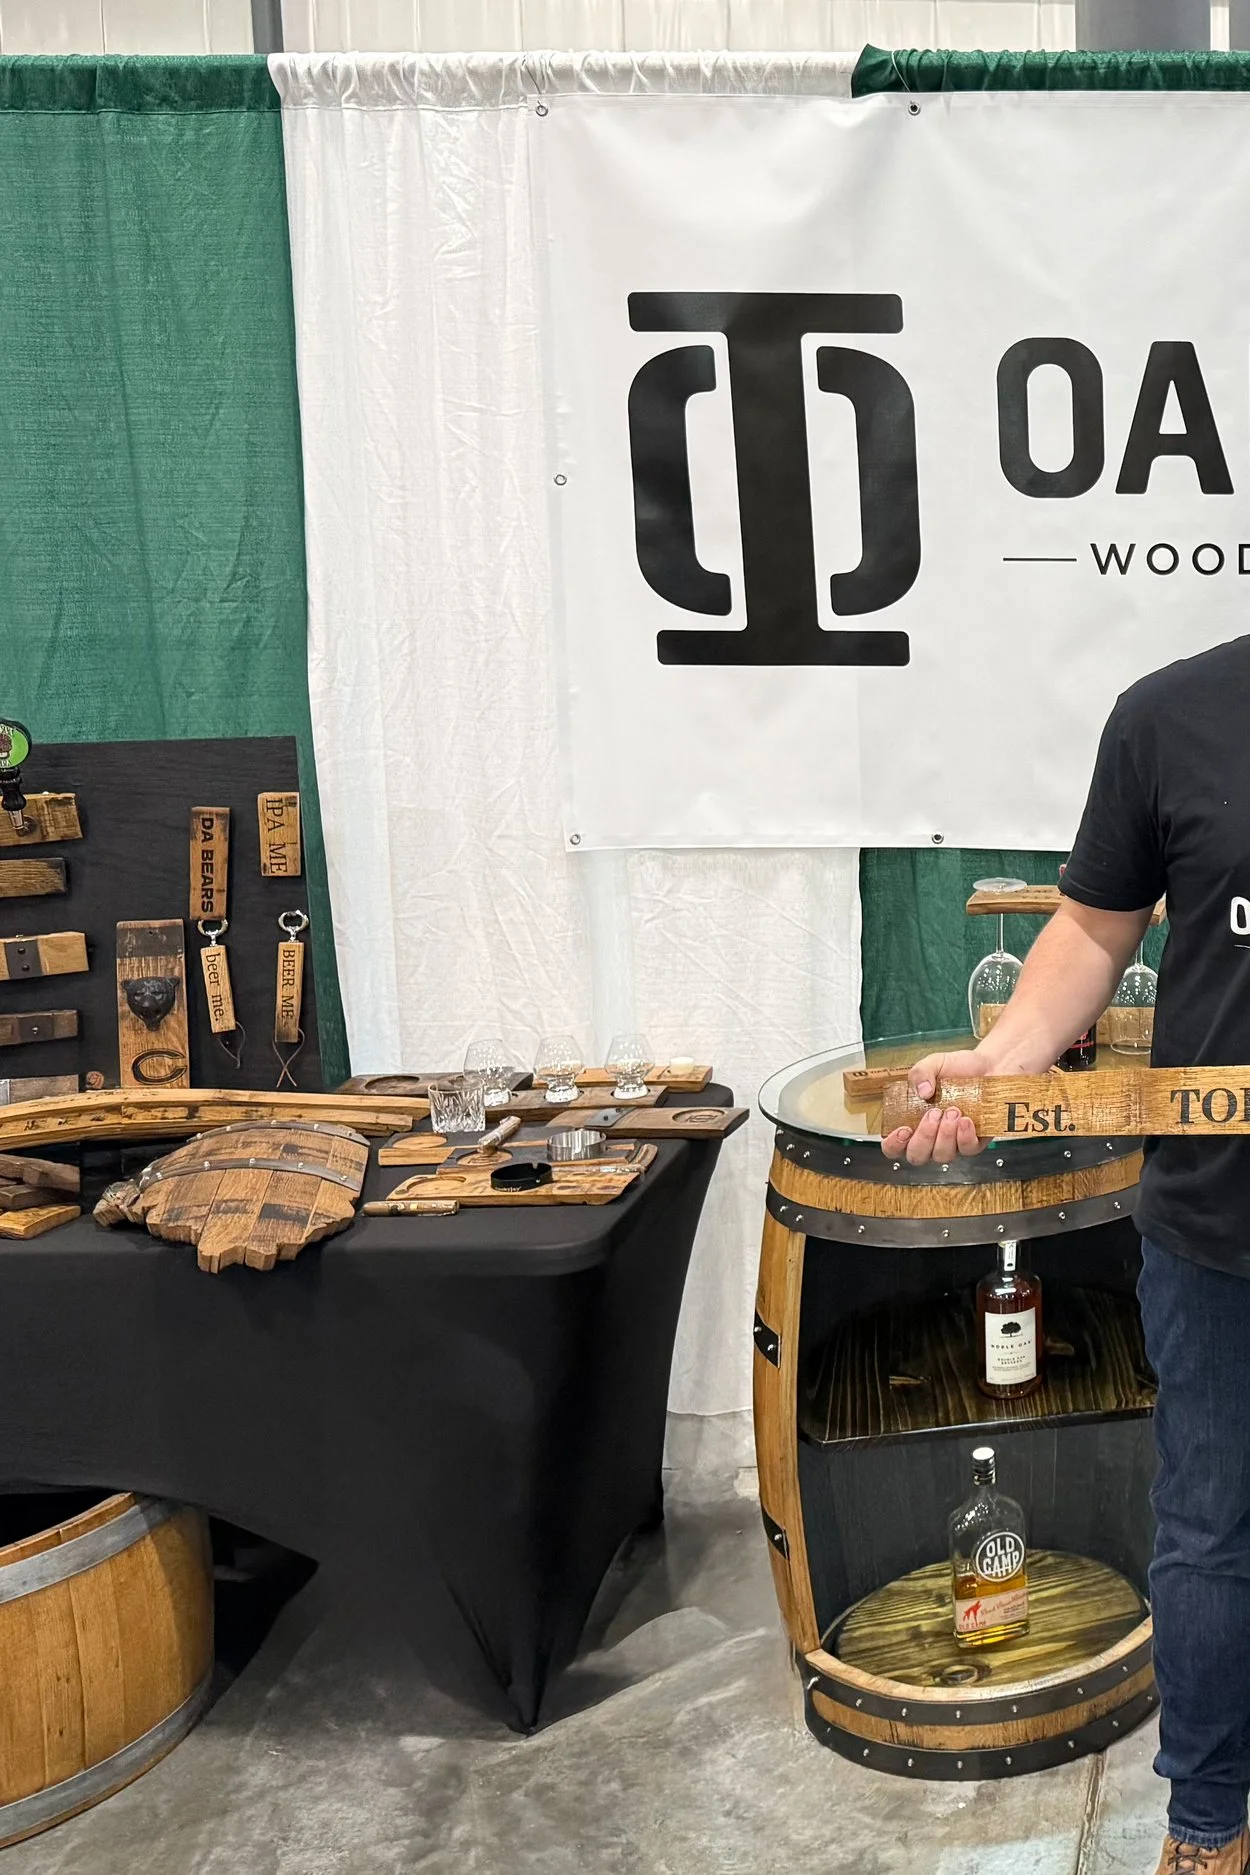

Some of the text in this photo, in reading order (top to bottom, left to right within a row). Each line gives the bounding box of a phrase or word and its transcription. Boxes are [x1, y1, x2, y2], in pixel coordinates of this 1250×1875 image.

[201, 817, 214, 913] DA BEARS
[265, 798, 288, 874] IPA ME
[206, 952, 224, 1022] beer me.
[281, 949, 295, 1019] BEER ME
[1003, 1101, 1076, 1133] Est.
[982, 1550, 1020, 1577] CAMP
[985, 1536, 1015, 1557] OLD
